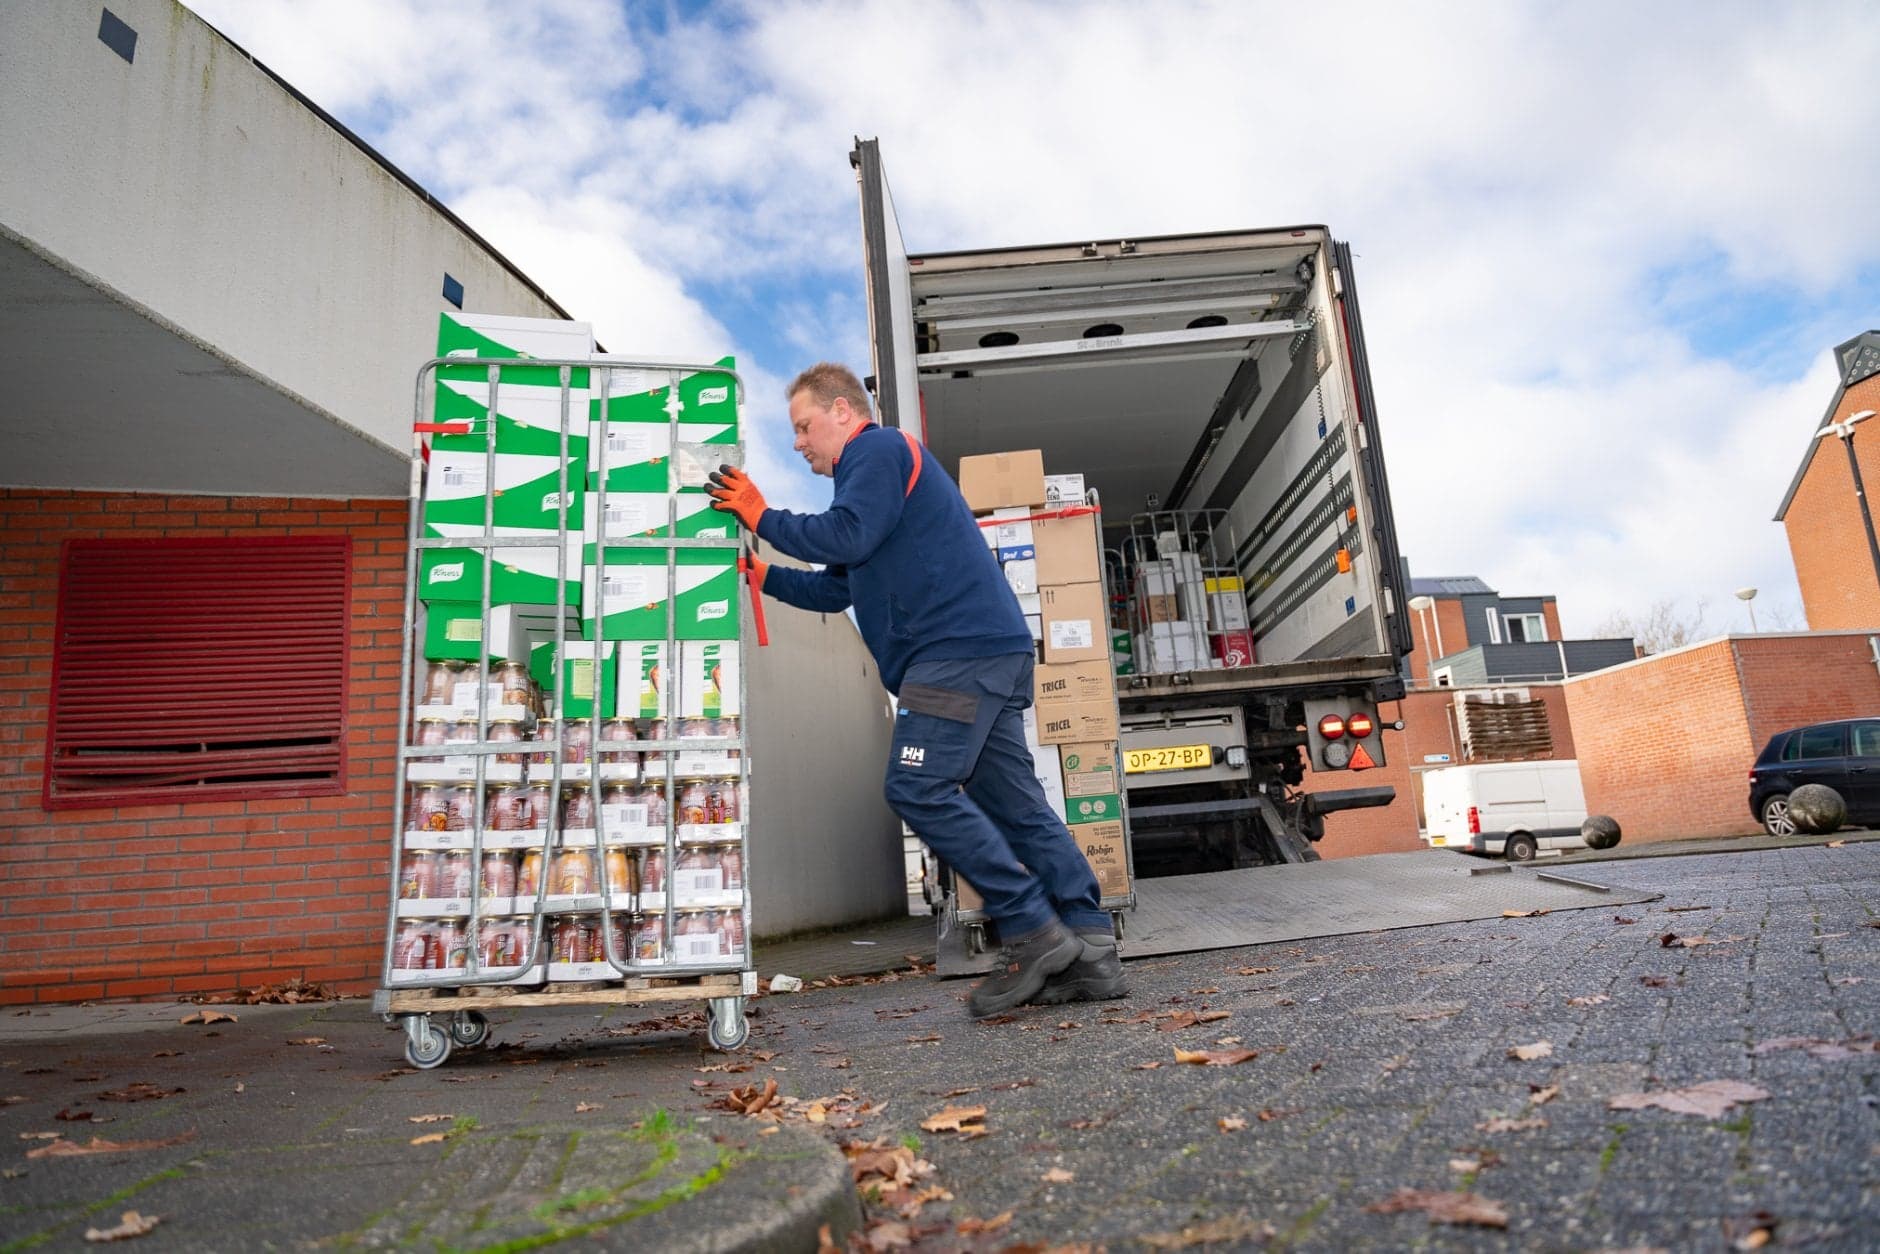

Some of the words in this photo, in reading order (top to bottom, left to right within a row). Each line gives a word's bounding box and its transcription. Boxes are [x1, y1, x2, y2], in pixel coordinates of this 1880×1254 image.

[1041, 679, 1066, 693] TRICEL
[1046, 719, 1071, 733] TRICEL
[902, 746, 924, 761] HH
[1130, 749, 1203, 767] OP-27-BP
[1086, 844, 1114, 856] Robijn
